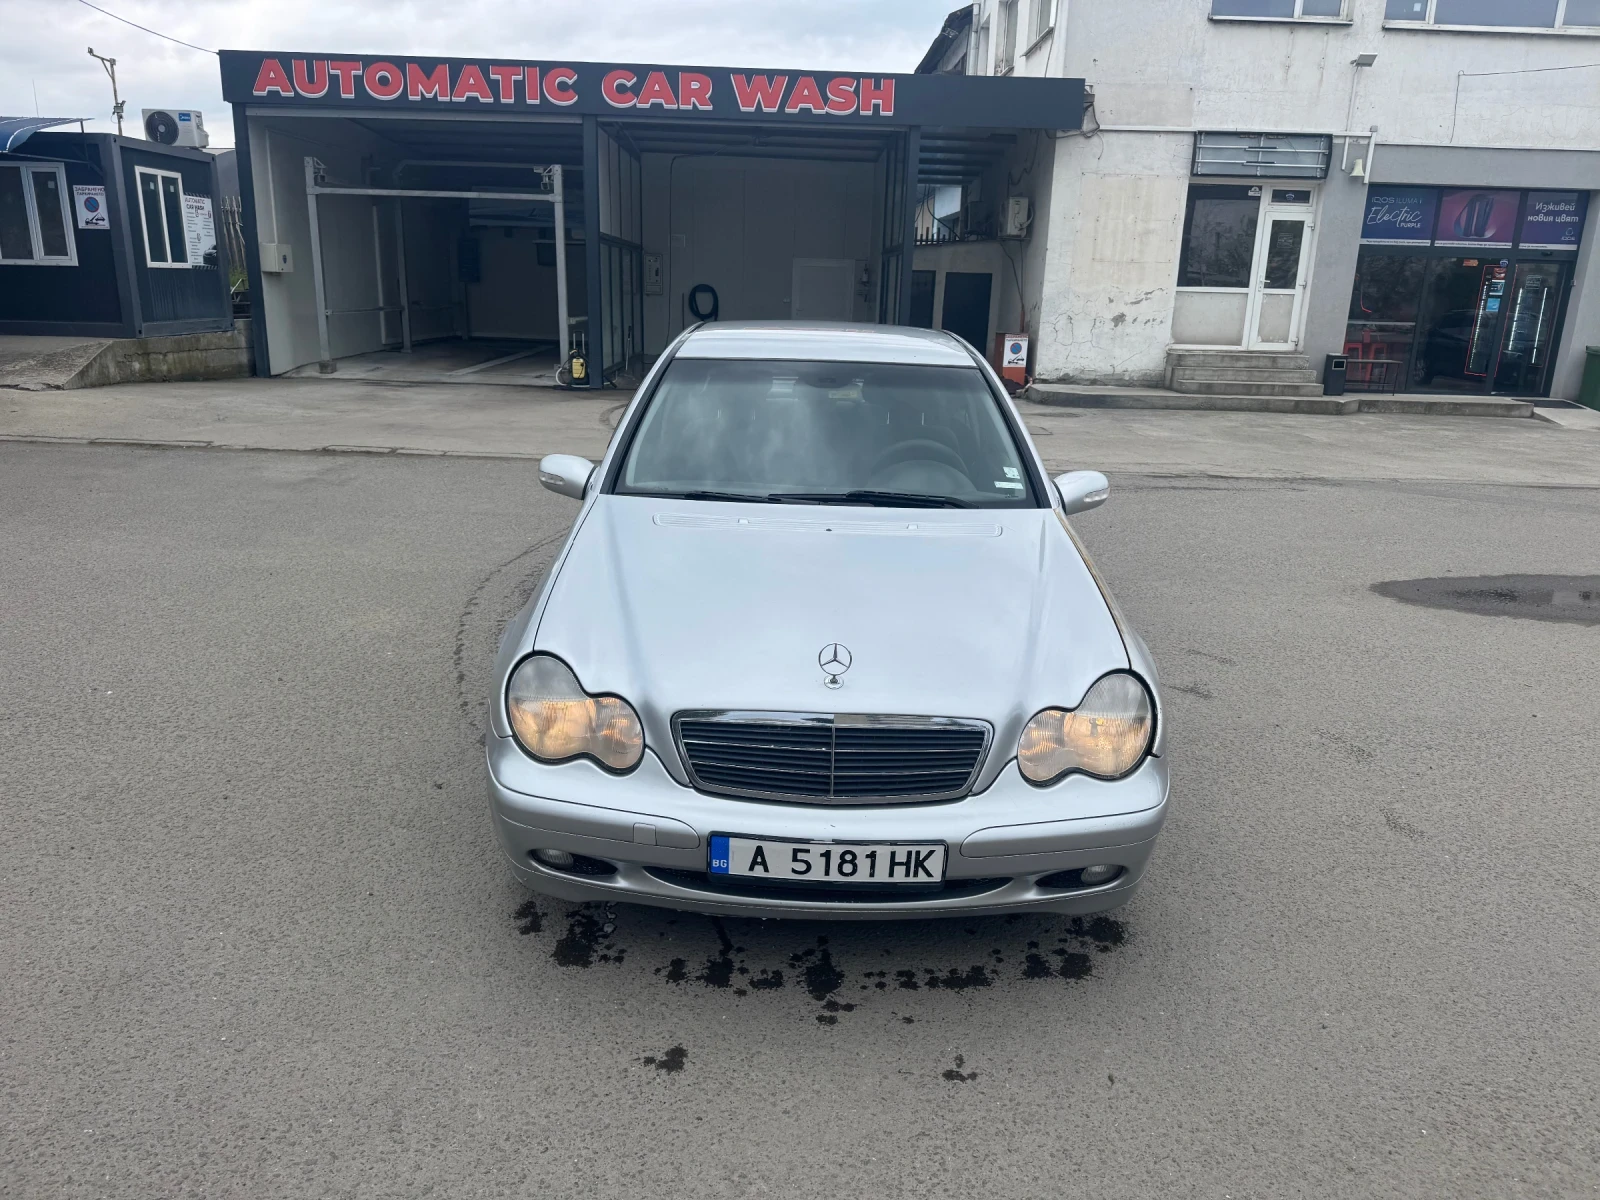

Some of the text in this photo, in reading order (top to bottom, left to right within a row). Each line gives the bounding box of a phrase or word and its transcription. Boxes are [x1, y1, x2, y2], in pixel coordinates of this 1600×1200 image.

[252, 58, 896, 116] AUTOMATIC CAR WASH
[1371, 196, 1395, 204] IQOS
[1535, 202, 1576, 213] Изживей
[1366, 205, 1422, 228] Electric
[1527, 213, 1579, 223] новия цвят
[712, 858, 728, 868] BG
